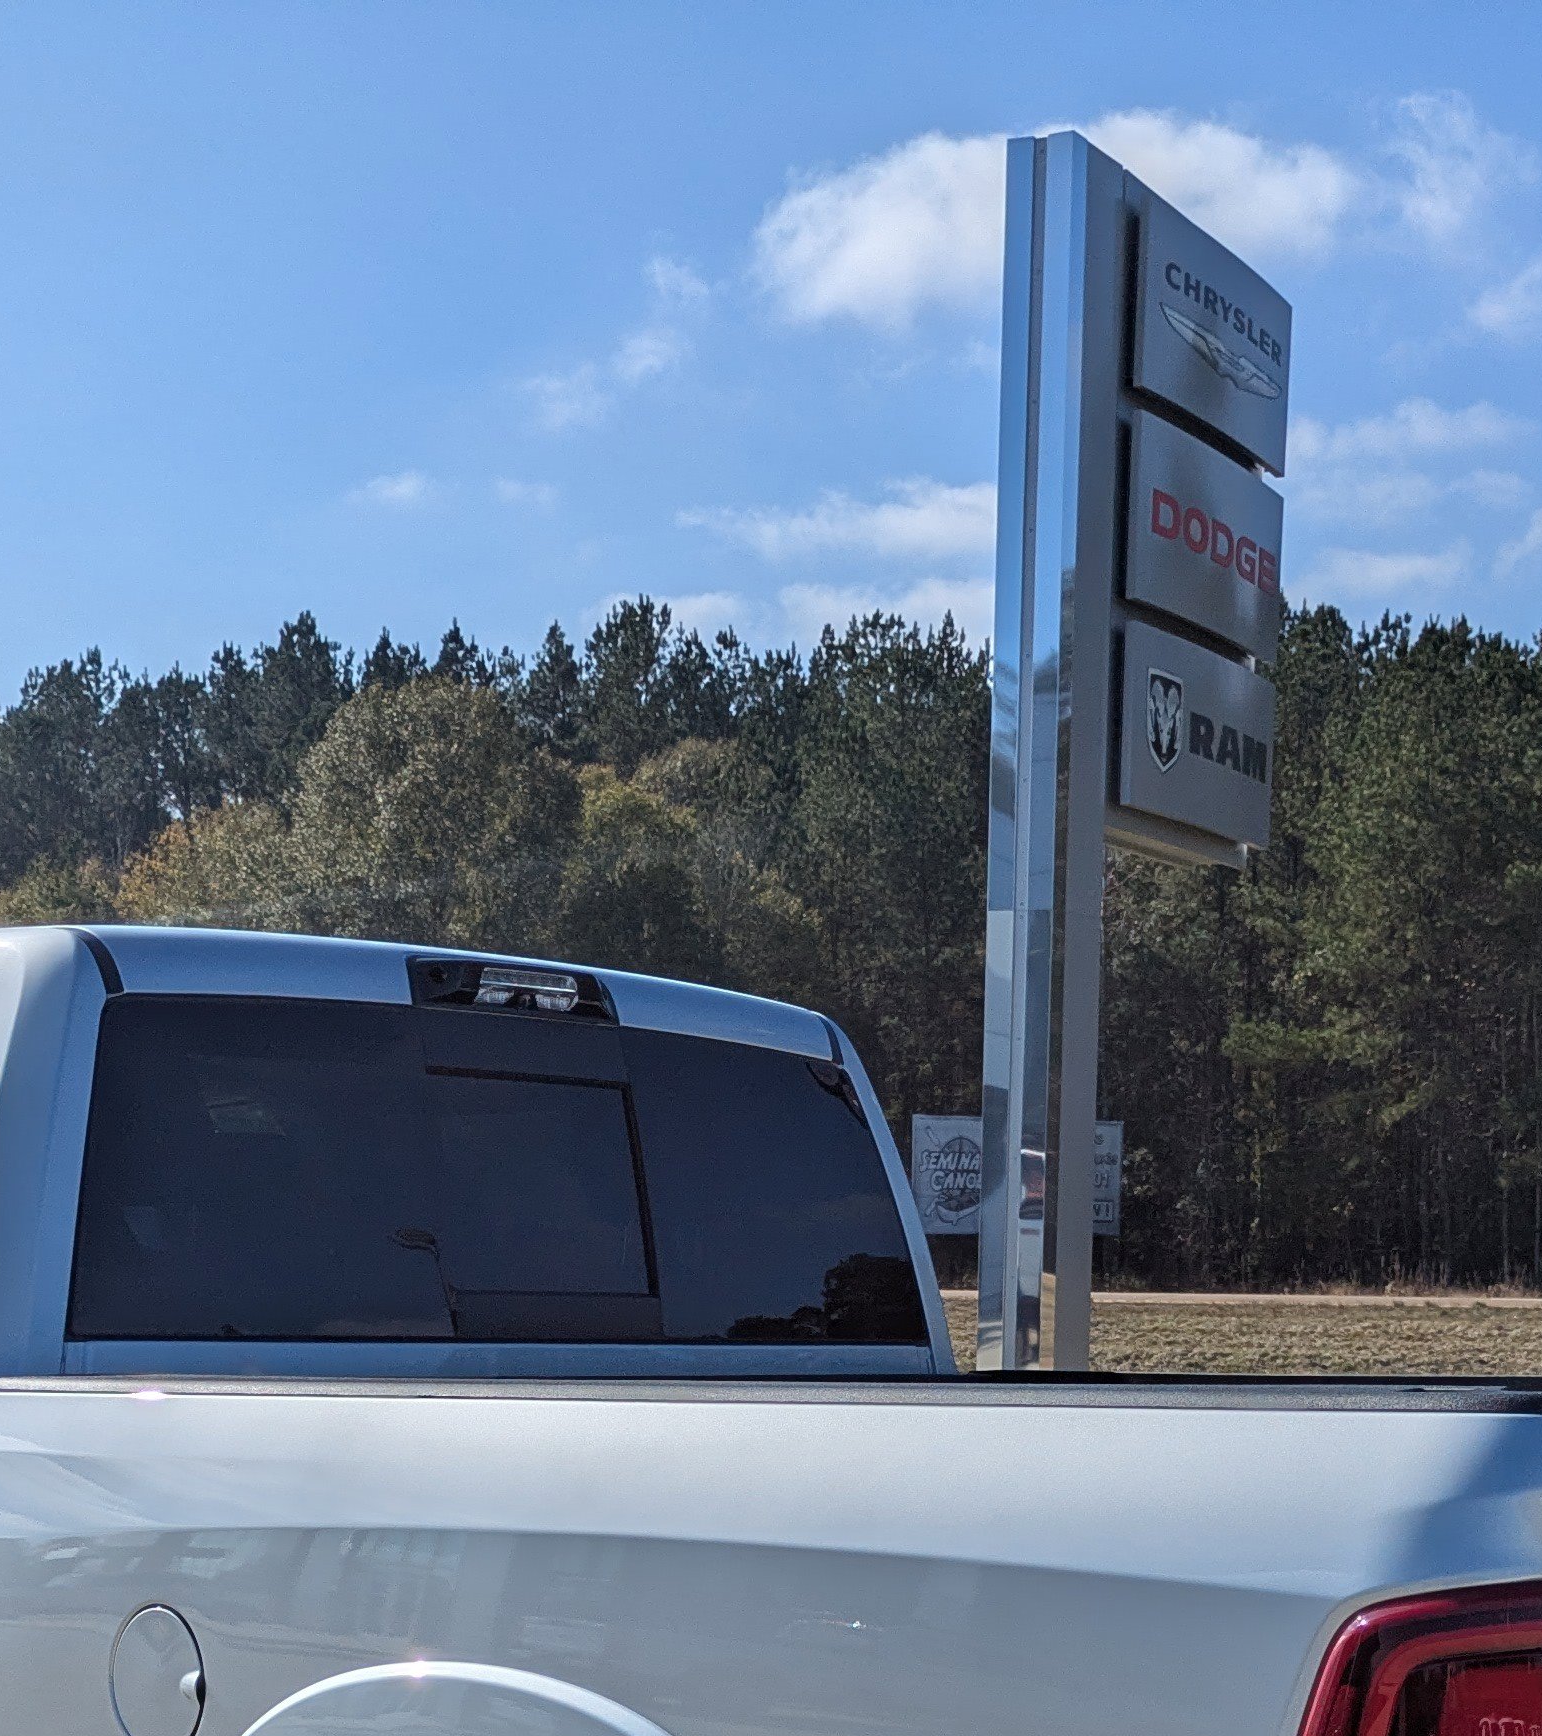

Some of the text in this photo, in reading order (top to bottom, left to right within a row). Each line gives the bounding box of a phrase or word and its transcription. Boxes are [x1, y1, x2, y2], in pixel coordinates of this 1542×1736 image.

[1164, 262, 1283, 368] CHRYSLER
[1151, 487, 1280, 598] DODGE
[1188, 711, 1268, 785] RAM
